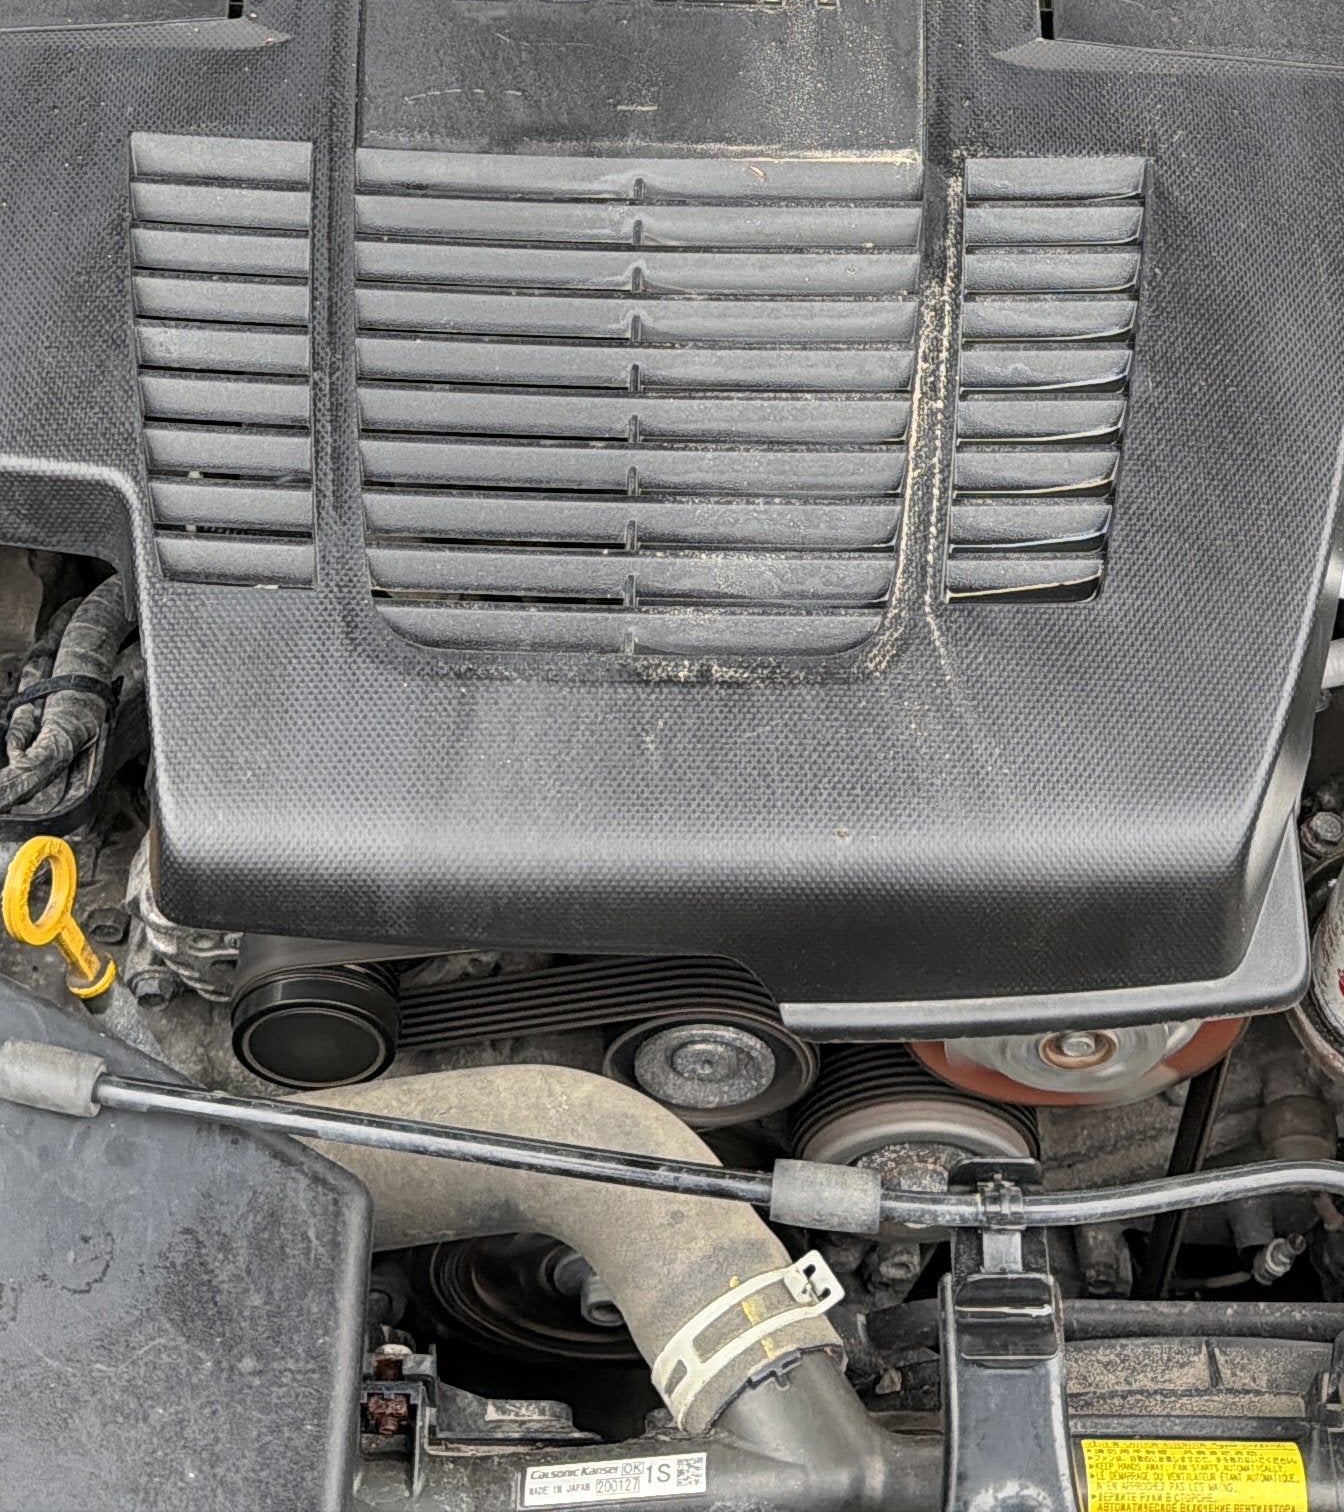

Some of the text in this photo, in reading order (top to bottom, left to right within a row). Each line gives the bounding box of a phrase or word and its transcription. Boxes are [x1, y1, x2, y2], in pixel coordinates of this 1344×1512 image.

[622, 1463, 643, 1475] OK
[646, 1463, 672, 1484] 1S
[529, 1487, 549, 1496] MADE
[566, 1483, 591, 1493] JAPAN
[596, 1478, 640, 1494] 200127
